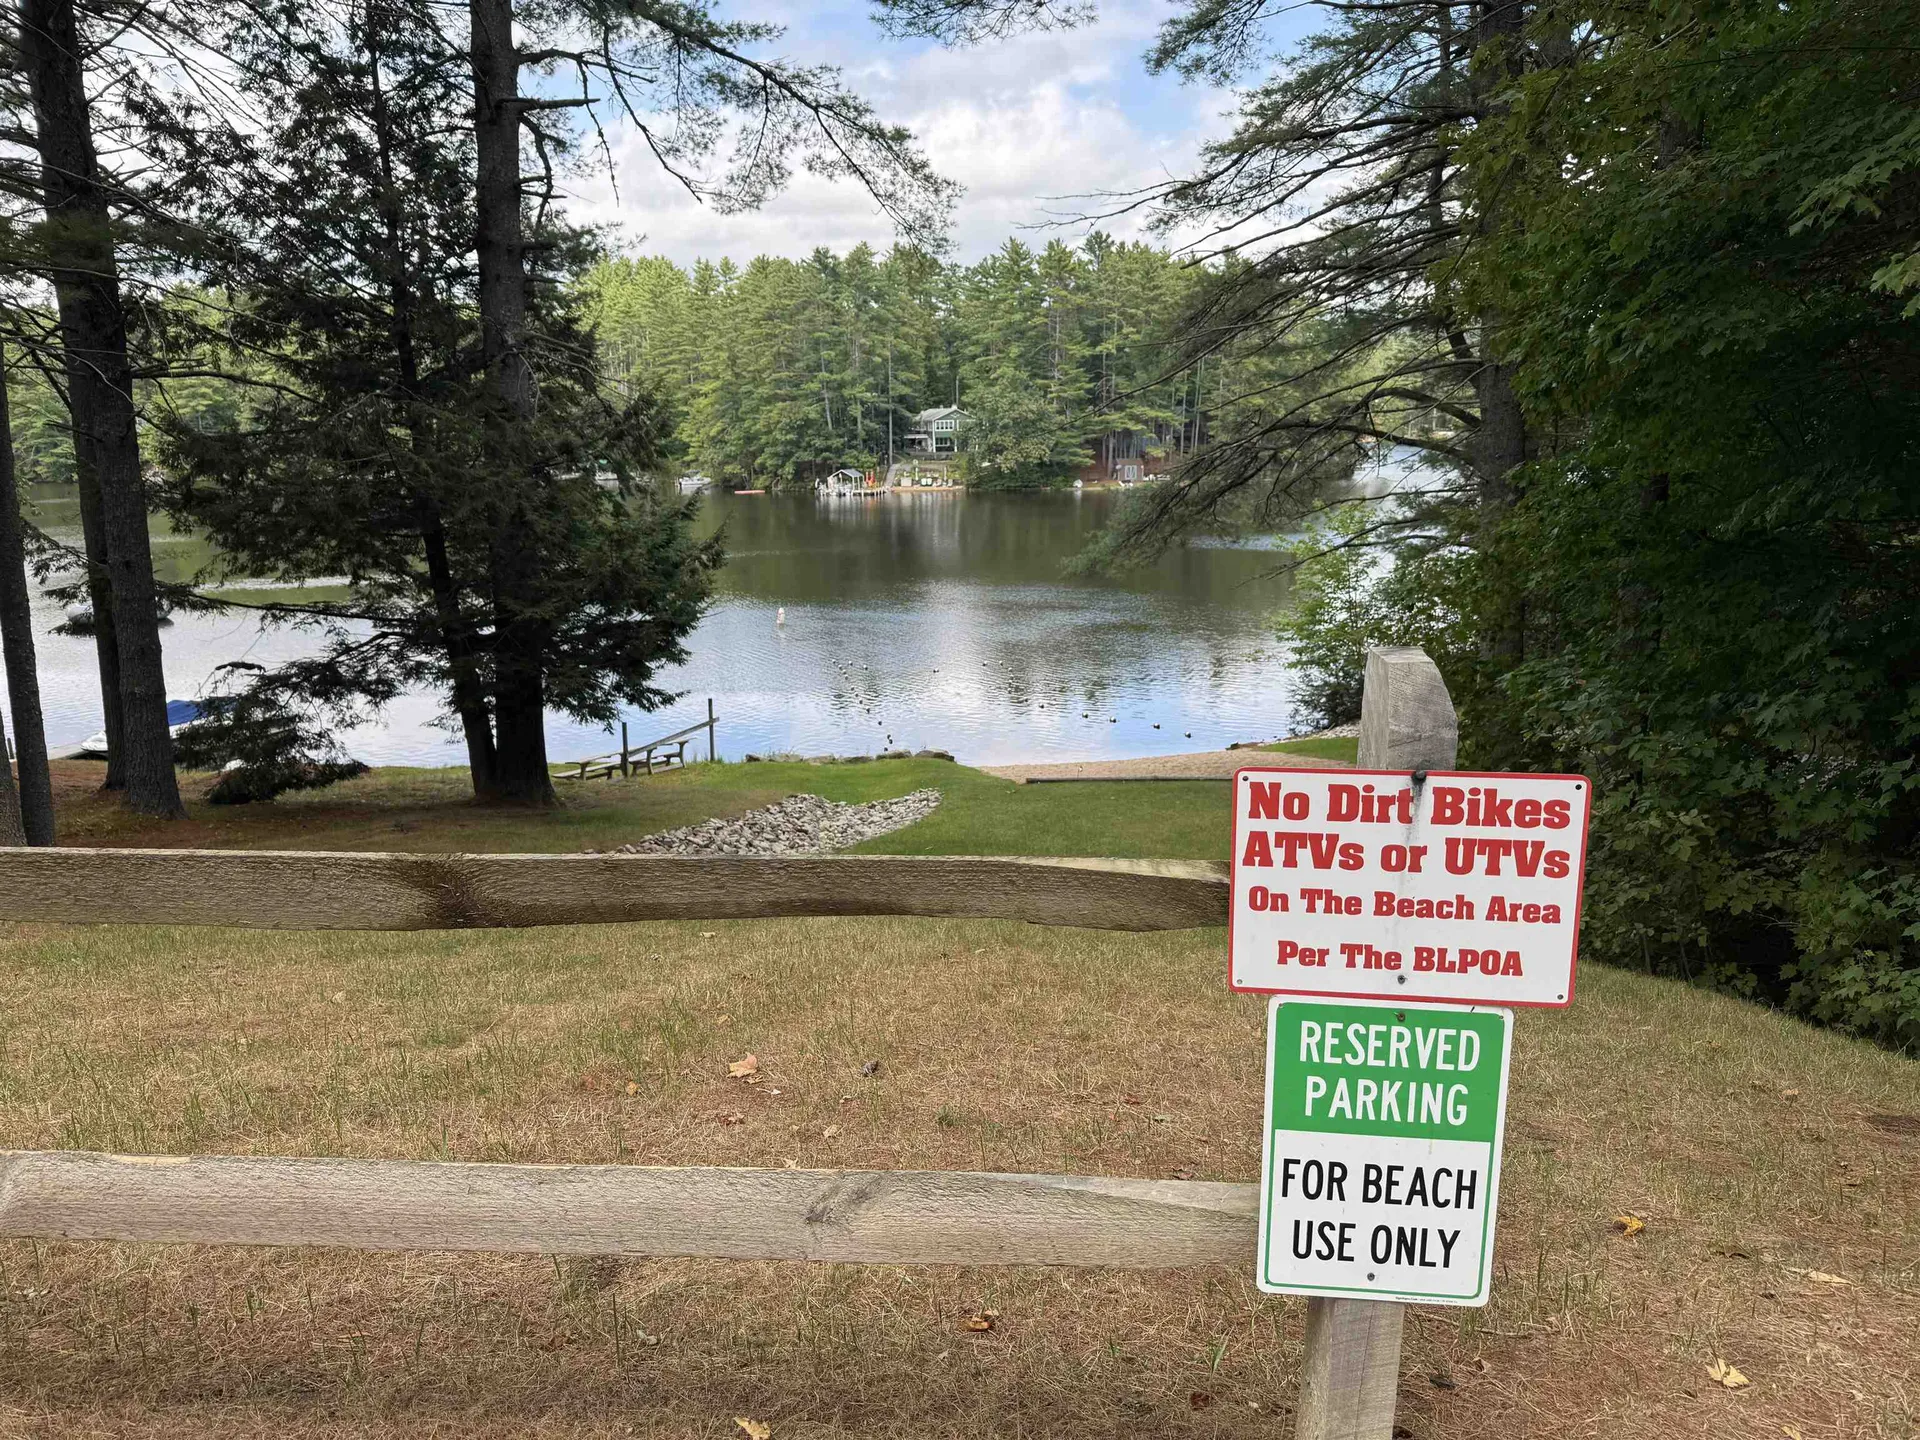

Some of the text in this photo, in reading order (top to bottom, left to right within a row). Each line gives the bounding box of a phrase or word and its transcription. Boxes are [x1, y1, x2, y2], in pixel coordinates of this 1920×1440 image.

[1248, 781, 1571, 829] No Dirt Bikes
[1242, 830, 1570, 879] ATVs or UTVs
[1248, 886, 1561, 924] On The Beach Area
[1277, 940, 1524, 977] Per The BLPOA
[1300, 1020, 1480, 1072] RESERVED
[1305, 1075, 1468, 1126] PARKING
[1281, 1158, 1478, 1210] FOR BEACH
[1292, 1219, 1461, 1268] USE ONLY
